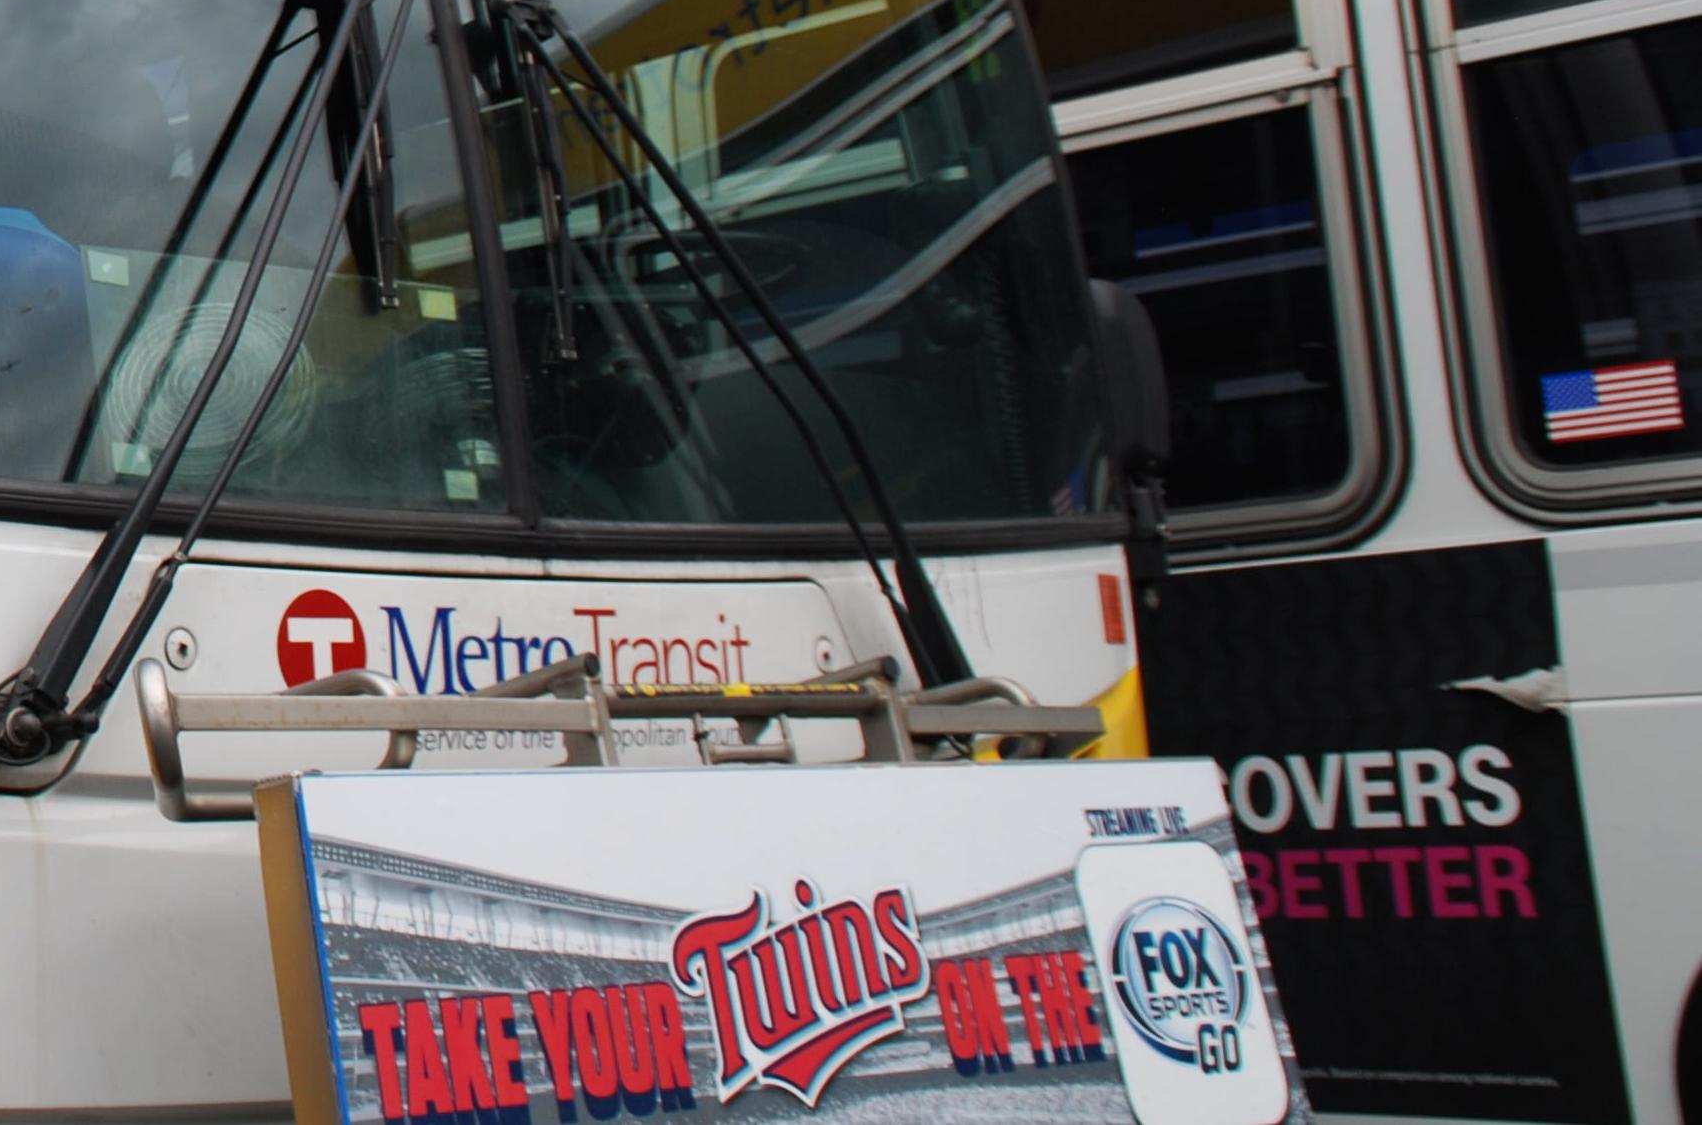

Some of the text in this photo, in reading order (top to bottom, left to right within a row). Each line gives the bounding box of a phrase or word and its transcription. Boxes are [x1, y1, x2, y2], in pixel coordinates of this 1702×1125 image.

[1085, 806, 1190, 837] STREAMING LIVE
[1217, 743, 1522, 834] OVERS
[1242, 844, 1539, 919] BETTER
[1132, 926, 1224, 995] FOX
[358, 876, 1104, 1125] TAKE YOUR Twins ON THE
[1148, 990, 1232, 1022] SPORTS
[1197, 1022, 1241, 1075] GO
